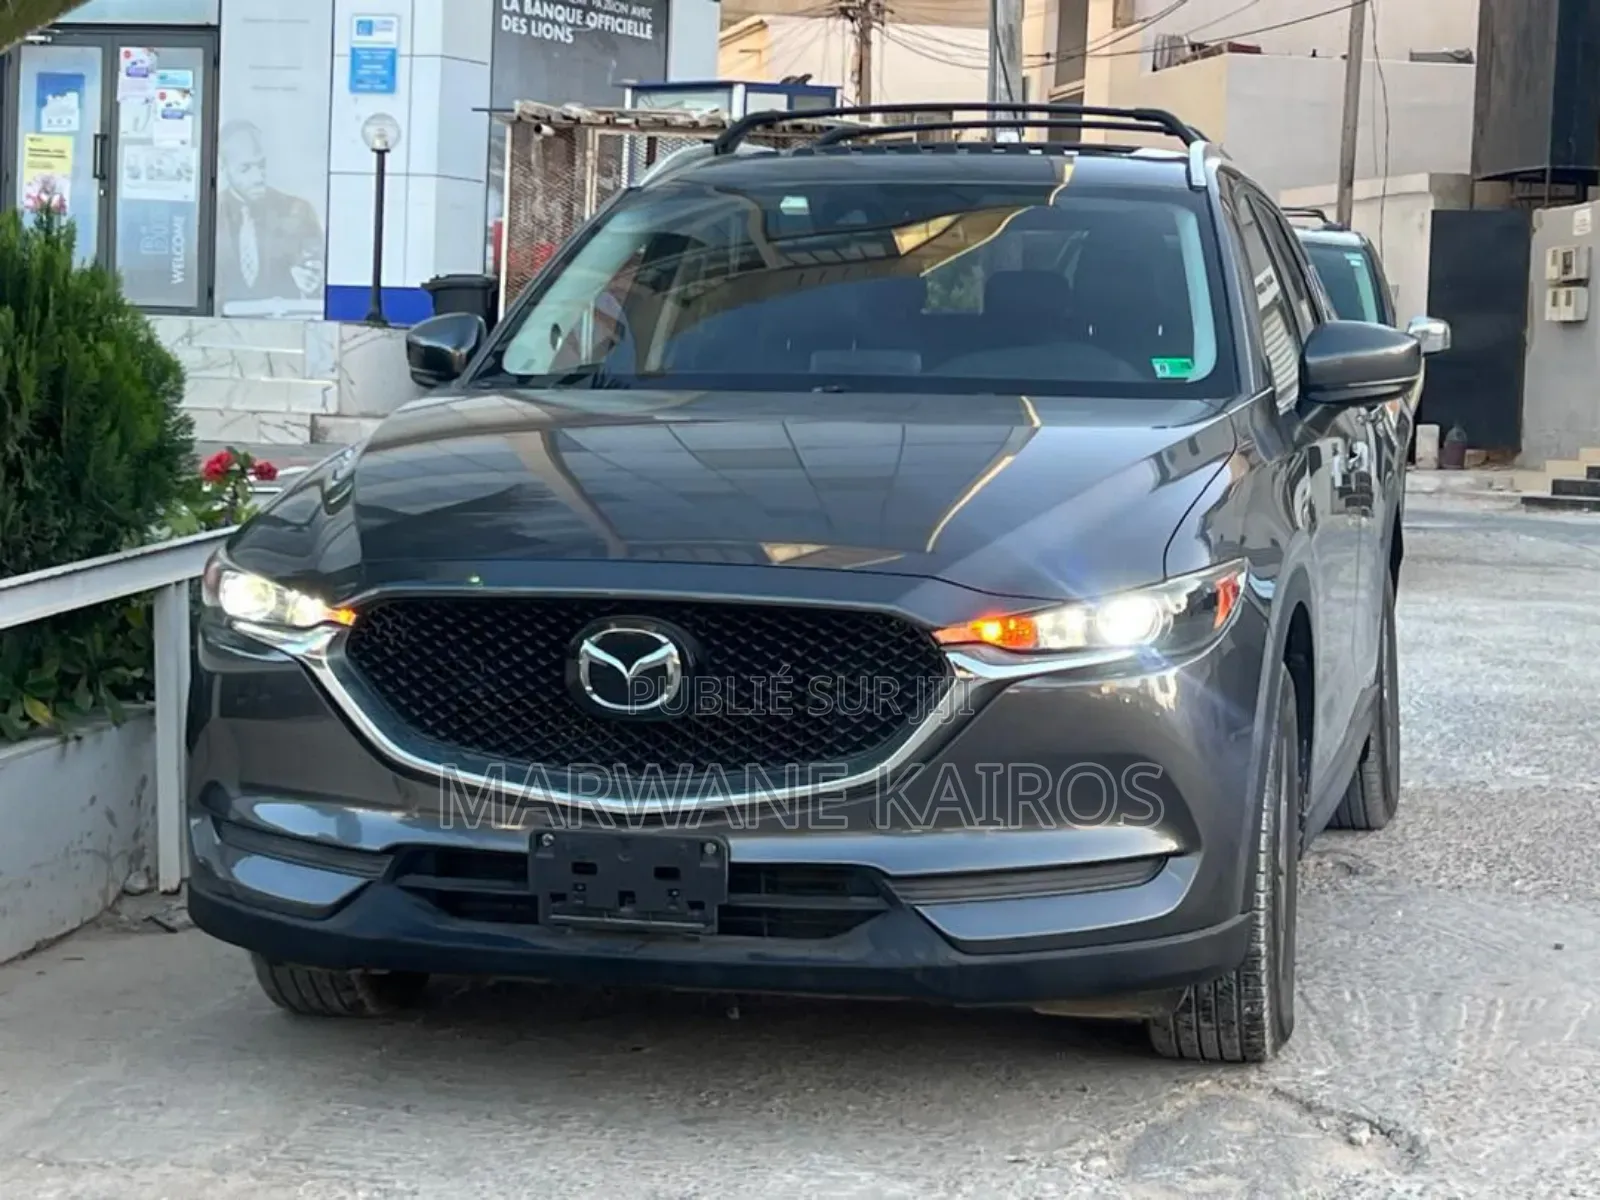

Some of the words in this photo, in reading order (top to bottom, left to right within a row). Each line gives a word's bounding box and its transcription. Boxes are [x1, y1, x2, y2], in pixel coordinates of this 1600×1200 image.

[502, 0, 520, 13] LA
[523, 0, 583, 25] BANQUE
[586, 11, 653, 40] OFFICIELLE
[502, 14, 528, 35] DES
[531, 19, 574, 44] LIONS
[630, 7, 652, 20] AVEC
[171, 215, 185, 284] WELCOME
